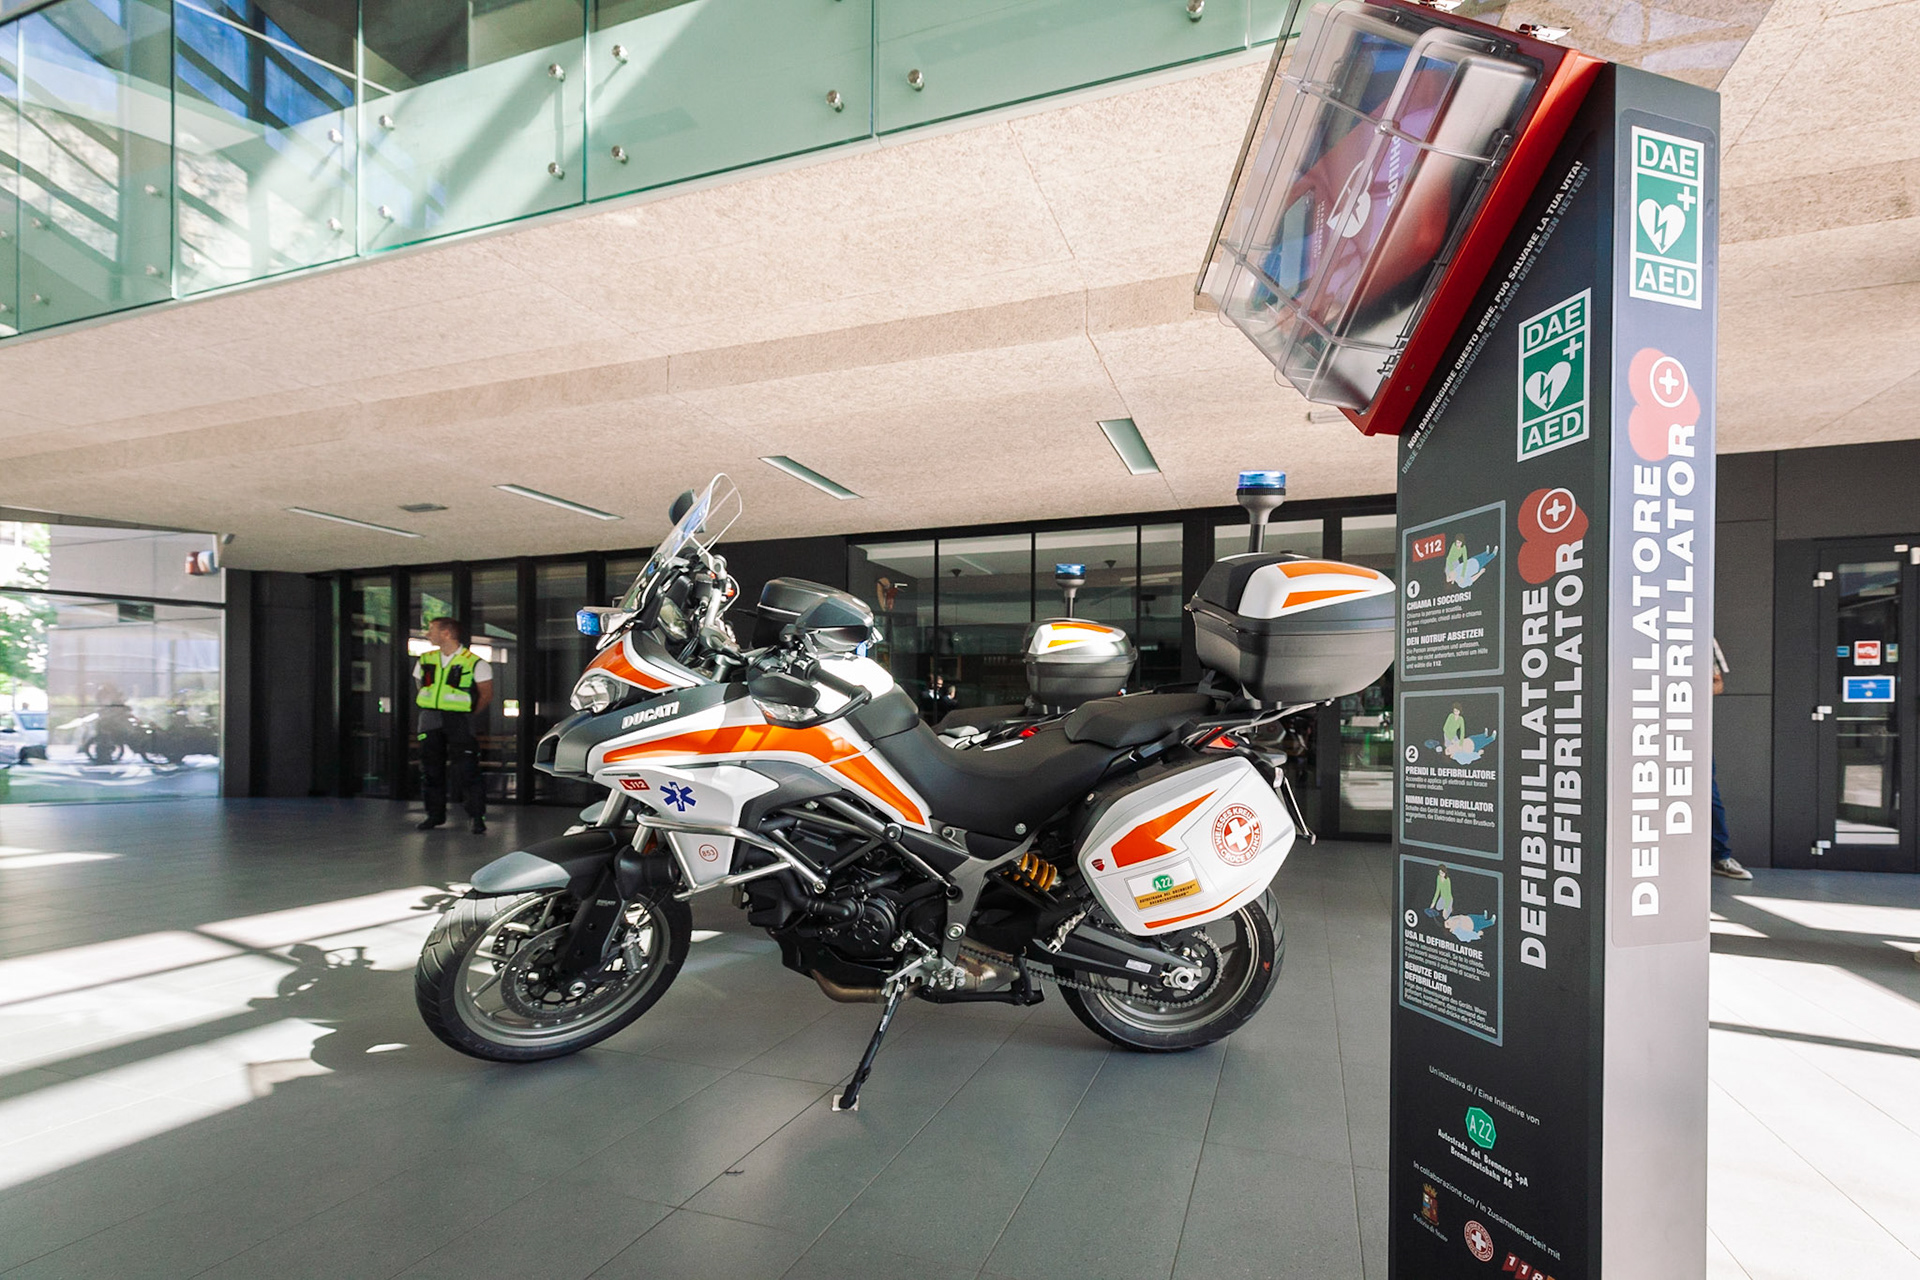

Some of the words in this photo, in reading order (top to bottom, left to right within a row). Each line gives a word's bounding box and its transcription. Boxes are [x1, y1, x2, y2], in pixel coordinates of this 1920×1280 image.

[1387, 136, 1401, 206] PHILIPS
[1640, 140, 1695, 177] DAE
[1638, 262, 1694, 297] AED
[1402, 450, 1418, 473] DIESE
[1415, 423, 1434, 450] SÄULE
[1433, 396, 1450, 423] NICHT
[1489, 312, 1501, 329] SIE
[1500, 282, 1520, 311] KANN
[1518, 255, 1536, 280] DEIN
[1535, 218, 1559, 253] LEBEN
[1560, 167, 1590, 215] RETTEN!
[1407, 430, 1420, 449] NON
[1419, 371, 1456, 430] DANNEGGIARE
[1455, 334, 1478, 369] QUESTO
[1477, 306, 1498, 332] BENE,
[1495, 282, 1510, 302] PUÒ
[1508, 234, 1539, 279] SALVARE
[1537, 218, 1549, 231] LA
[1546, 194, 1563, 214] TUA
[1561, 161, 1582, 190] VITA!
[1527, 300, 1582, 350] DAE
[1525, 411, 1580, 451] AED
[1424, 539, 1442, 554] 112
[1407, 600, 1431, 610] CHIAMA
[1437, 592, 1471, 605] SOCCORSI
[1407, 637, 1419, 646] DEN
[1421, 633, 1446, 644] NOTRUF
[1448, 629, 1483, 640] ABSETZEN
[1666, 424, 1695, 834] DEFIBRILLATOR
[1632, 464, 1661, 916] DEFIBRILLATORE
[621, 701, 680, 729] DUCATI
[1554, 540, 1584, 908] DEFIBRILLATOR
[1409, 748, 1415, 759] 2
[1406, 766, 1428, 775] PRENDI
[1430, 768, 1436, 776] IL
[1438, 768, 1495, 779] DEFIBRILLATORE
[1520, 586, 1548, 969] DEFIBRILLATORE
[1406, 796, 1424, 804] NIMM
[1425, 797, 1438, 806] DEN
[1440, 799, 1493, 811] DEFIBRILLATOR
[1215, 809, 1232, 845] WEISSES
[1220, 849, 1245, 862] CROCE
[1245, 828, 1260, 858] BIANCA
[1154, 876, 1173, 890] A22
[1408, 914, 1415, 923] 3
[1405, 930, 1417, 940] USA
[1419, 934, 1425, 942] IL
[1427, 937, 1482, 959] DEFIBRILLATORE
[1405, 962, 1432, 977] BENUTZE
[1434, 971, 1447, 982] DEN
[1405, 972, 1452, 994] DEFIBRILLATOR
[1467, 1084, 1473, 1092] di
[1478, 1089, 1493, 1103] Eine
[1494, 1097, 1525, 1118] Initiative
[1526, 1113, 1540, 1126] von
[1438, 1128, 1467, 1152] Autostrada
[1471, 1147, 1481, 1160] del
[1484, 1154, 1512, 1177] Brennero
[1515, 1172, 1528, 1187] SpA
[1450, 1146, 1500, 1182] Brennerautobahn
[1503, 1177, 1513, 1189] AG
[1420, 1166, 1462, 1198] collaborazione
[1463, 1193, 1475, 1204] con
[1487, 1206, 1546, 1252] Zusammenarbeit
[1548, 1247, 1560, 1260] mit
